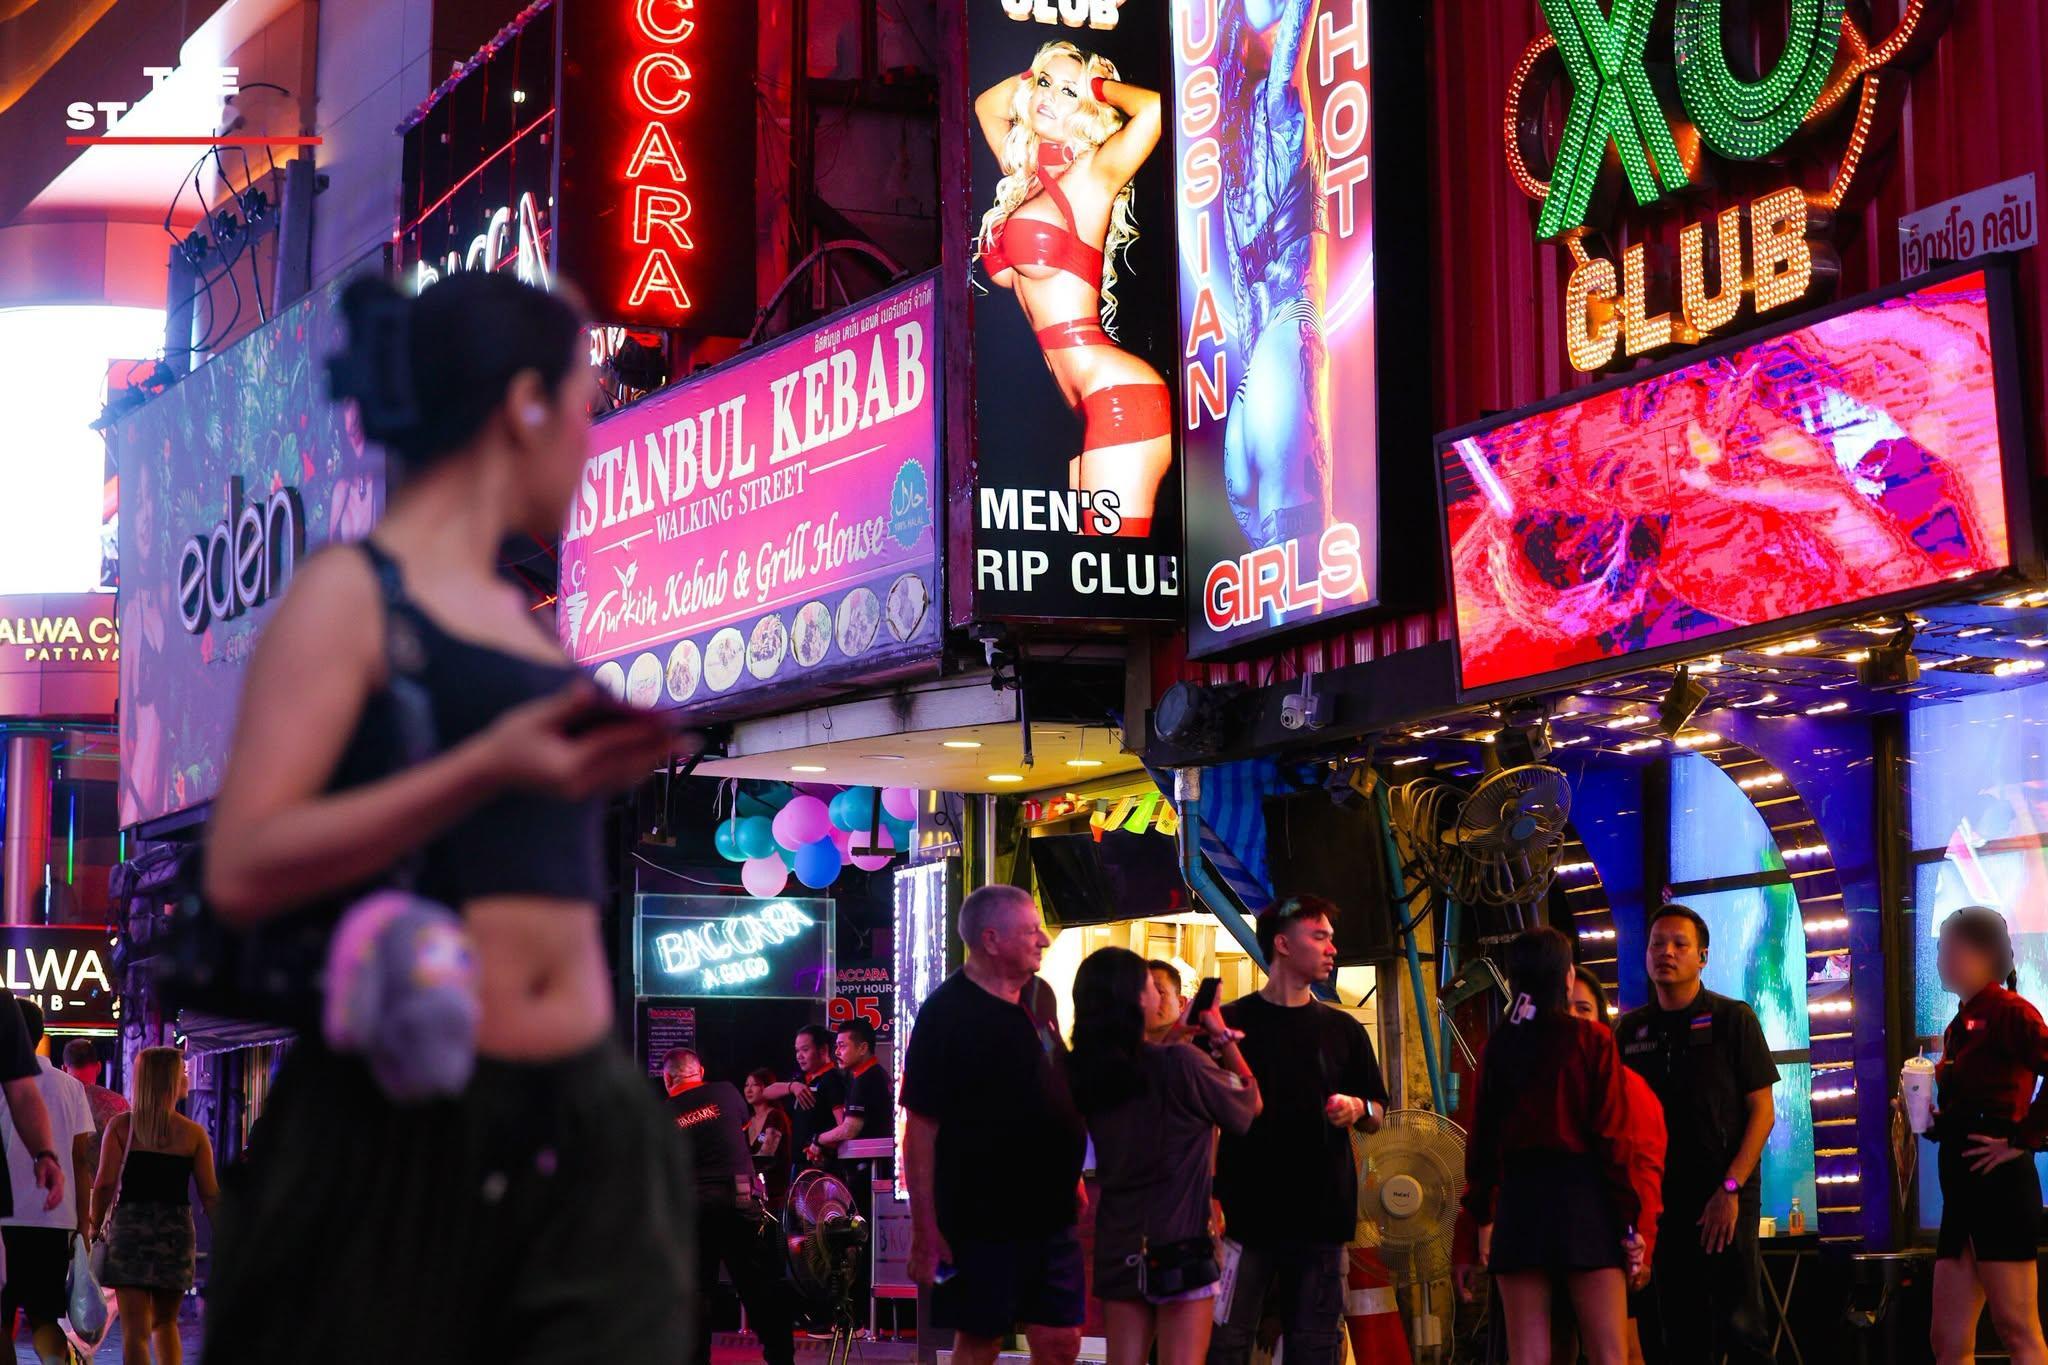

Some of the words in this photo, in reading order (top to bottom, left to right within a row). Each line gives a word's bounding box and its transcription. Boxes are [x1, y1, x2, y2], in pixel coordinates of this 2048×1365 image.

[1318, 0, 1369, 239] HOT
[1982, 194, 2033, 252] คลับ
[1566, 186, 1812, 373] CLUB
[566, 394, 756, 543] ISTANBUL
[770, 320, 926, 462] KEBAB
[655, 489, 734, 545] WALKING
[738, 460, 808, 516] STREET
[979, 486, 1123, 536] MEN'S
[178, 474, 305, 635] eden
[585, 557, 658, 644] Turkish
[662, 550, 729, 622] Kebab
[733, 550, 752, 601] &
[756, 520, 812, 604] Grill
[809, 511, 885, 577] House
[976, 548, 1050, 592] RIP
[1203, 522, 1362, 633] GIRLS
[88, 616, 120, 645] C
[0, 948, 111, 992] LWA
[655, 900, 815, 974] BACCARA
[835, 984, 861, 994] APPY
[836, 967, 889, 982] ACCARA
